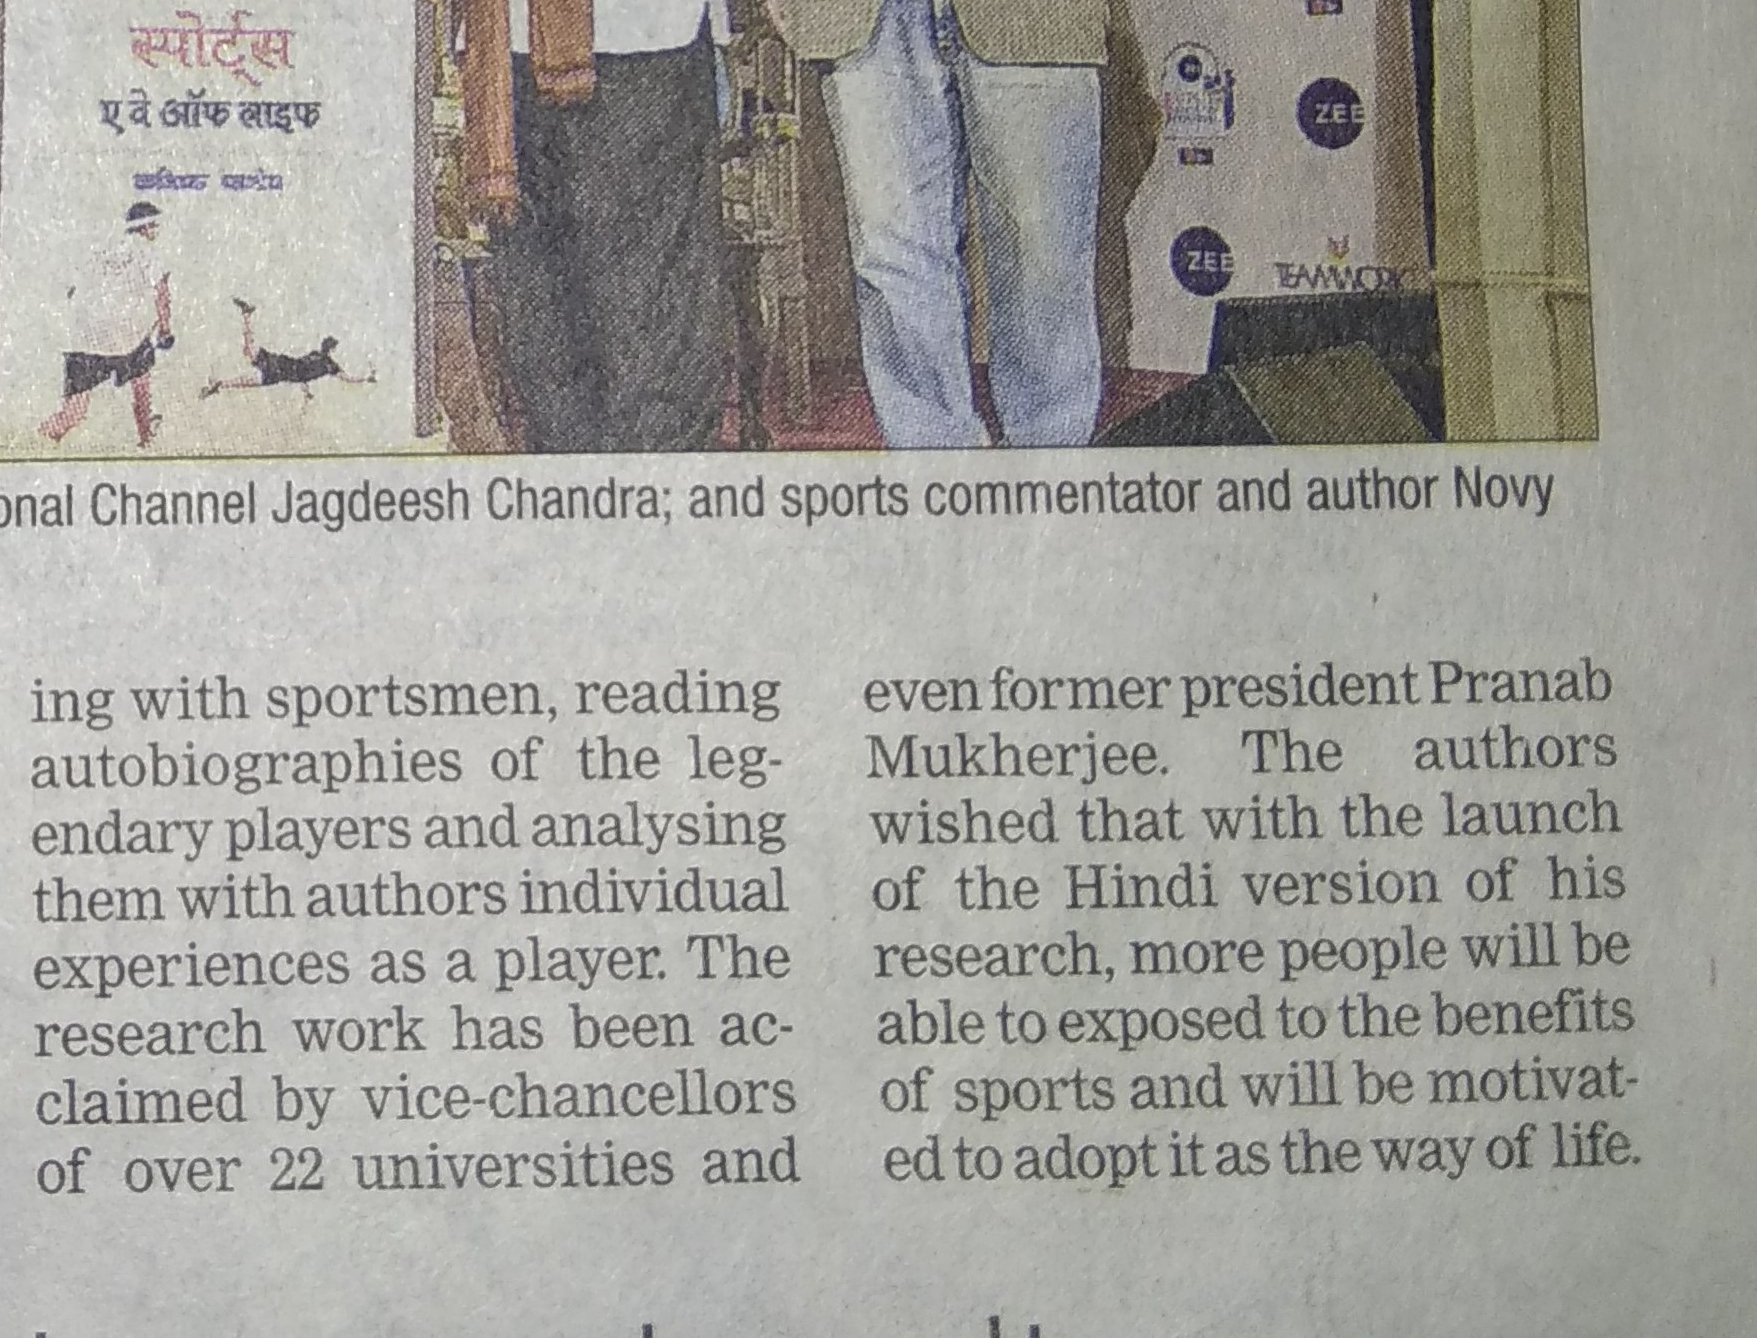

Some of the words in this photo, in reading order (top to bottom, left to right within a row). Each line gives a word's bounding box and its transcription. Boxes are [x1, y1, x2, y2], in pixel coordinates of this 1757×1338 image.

[99, 98, 125, 136] ए
[127, 87, 153, 128] वे
[159, 87, 233, 128] ऑफ
[238, 99, 322, 134] लाइफ
[1314, 102, 1365, 125] ZEE
[1186, 249, 1234, 273] ZEE
[1275, 262, 1405, 293] TEAMWORK
[90, 480, 256, 526] Channel
[272, 478, 469, 533] Jagdeesh
[487, 477, 671, 525] Chandra;
[689, 476, 764, 519] and
[781, 475, 909, 527] sports
[924, 471, 1202, 517] commentator
[1217, 468, 1291, 513] and
[1307, 467, 1439, 511] author
[1454, 465, 1554, 517] Novy
[31, 678, 115, 731] ing
[130, 674, 250, 720] with
[267, 675, 557, 728] sportsmen,
[576, 668, 781, 722] reading
[866, 731, 1168, 785] Mukherjee.
[1241, 727, 1342, 774] The
[1415, 723, 1617, 771] authors
[33, 941, 350, 999] experiences
[371, 949, 426, 984] as
[446, 949, 477, 983] a
[495, 935, 666, 993] player.
[687, 933, 790, 979] The
[873, 929, 1115, 983] research,
[1129, 939, 1264, 975] more
[1278, 924, 1447, 982] people
[1461, 921, 1561, 969] will
[1571, 920, 1630, 966] be
[36, 1075, 247, 1125] claimed
[272, 1074, 335, 1131] by
[361, 1068, 797, 1120] vice-chancellors
[37, 1146, 92, 1195] of
[125, 1157, 242, 1193] over
[270, 1147, 324, 1191] 22
[352, 1140, 674, 1190] universities
[703, 1134, 801, 1185] and
